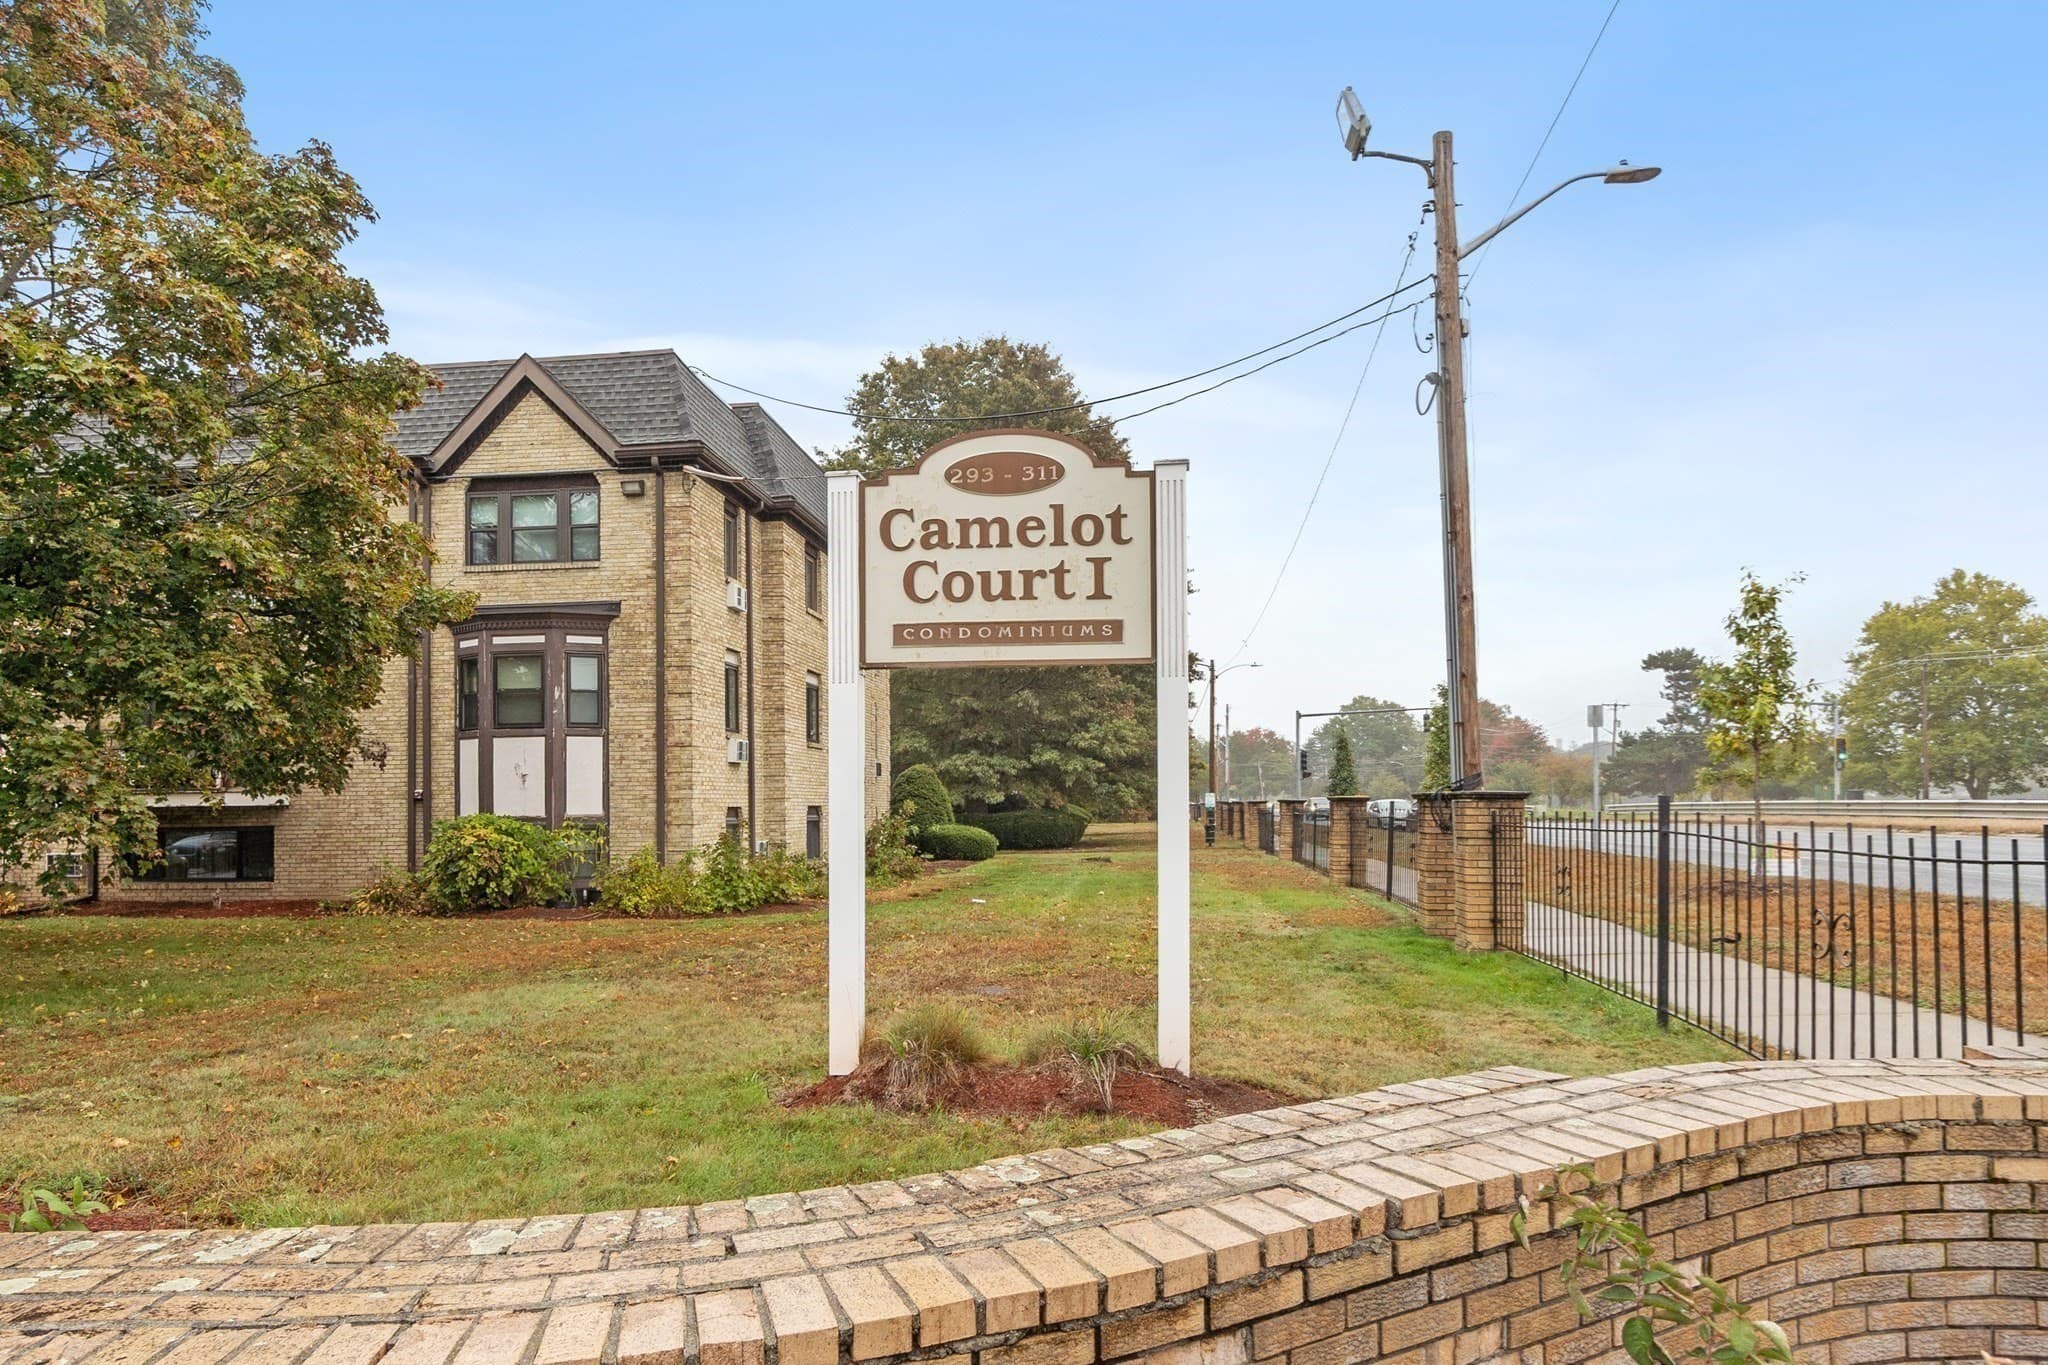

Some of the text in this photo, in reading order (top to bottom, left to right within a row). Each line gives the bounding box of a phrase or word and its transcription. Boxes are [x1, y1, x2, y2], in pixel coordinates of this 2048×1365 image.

[950, 467, 994, 484] 293
[1021, 465, 1058, 481] 311
[879, 504, 1133, 552] Camelot
[902, 556, 1113, 604] Court I
[903, 624, 1113, 640] CONDOMINIUMS
